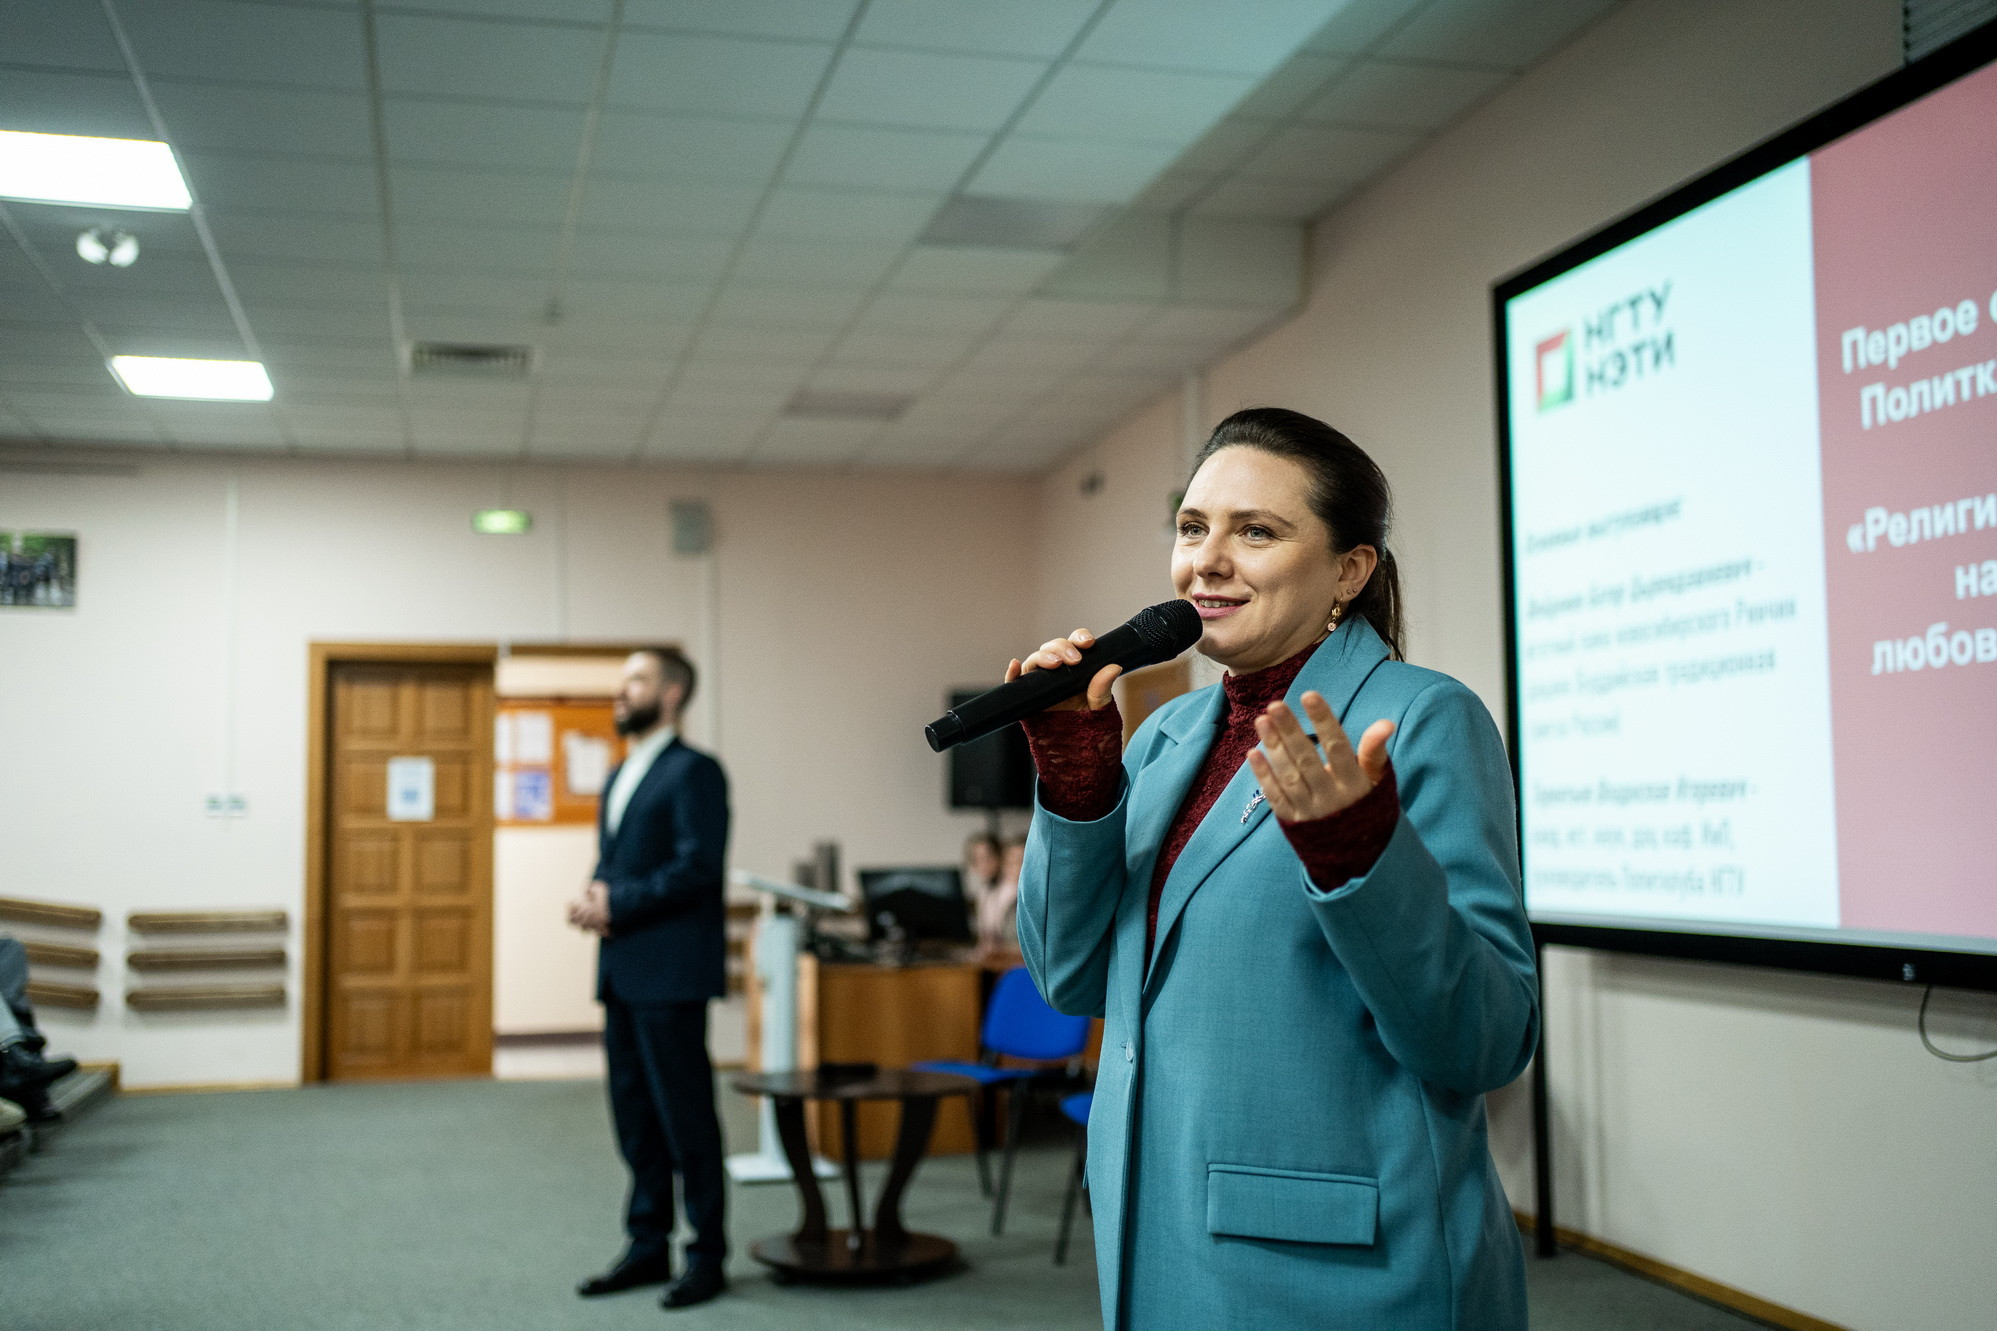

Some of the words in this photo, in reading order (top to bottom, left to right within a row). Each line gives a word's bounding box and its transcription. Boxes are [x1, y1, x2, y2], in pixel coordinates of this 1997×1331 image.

[1583, 279, 1674, 351] НГТУ
[1841, 299, 1979, 374] Первое
[1584, 328, 1676, 397] НЭТИ
[1860, 359, 1997, 430] Политк
[1871, 621, 1997, 676] любов
